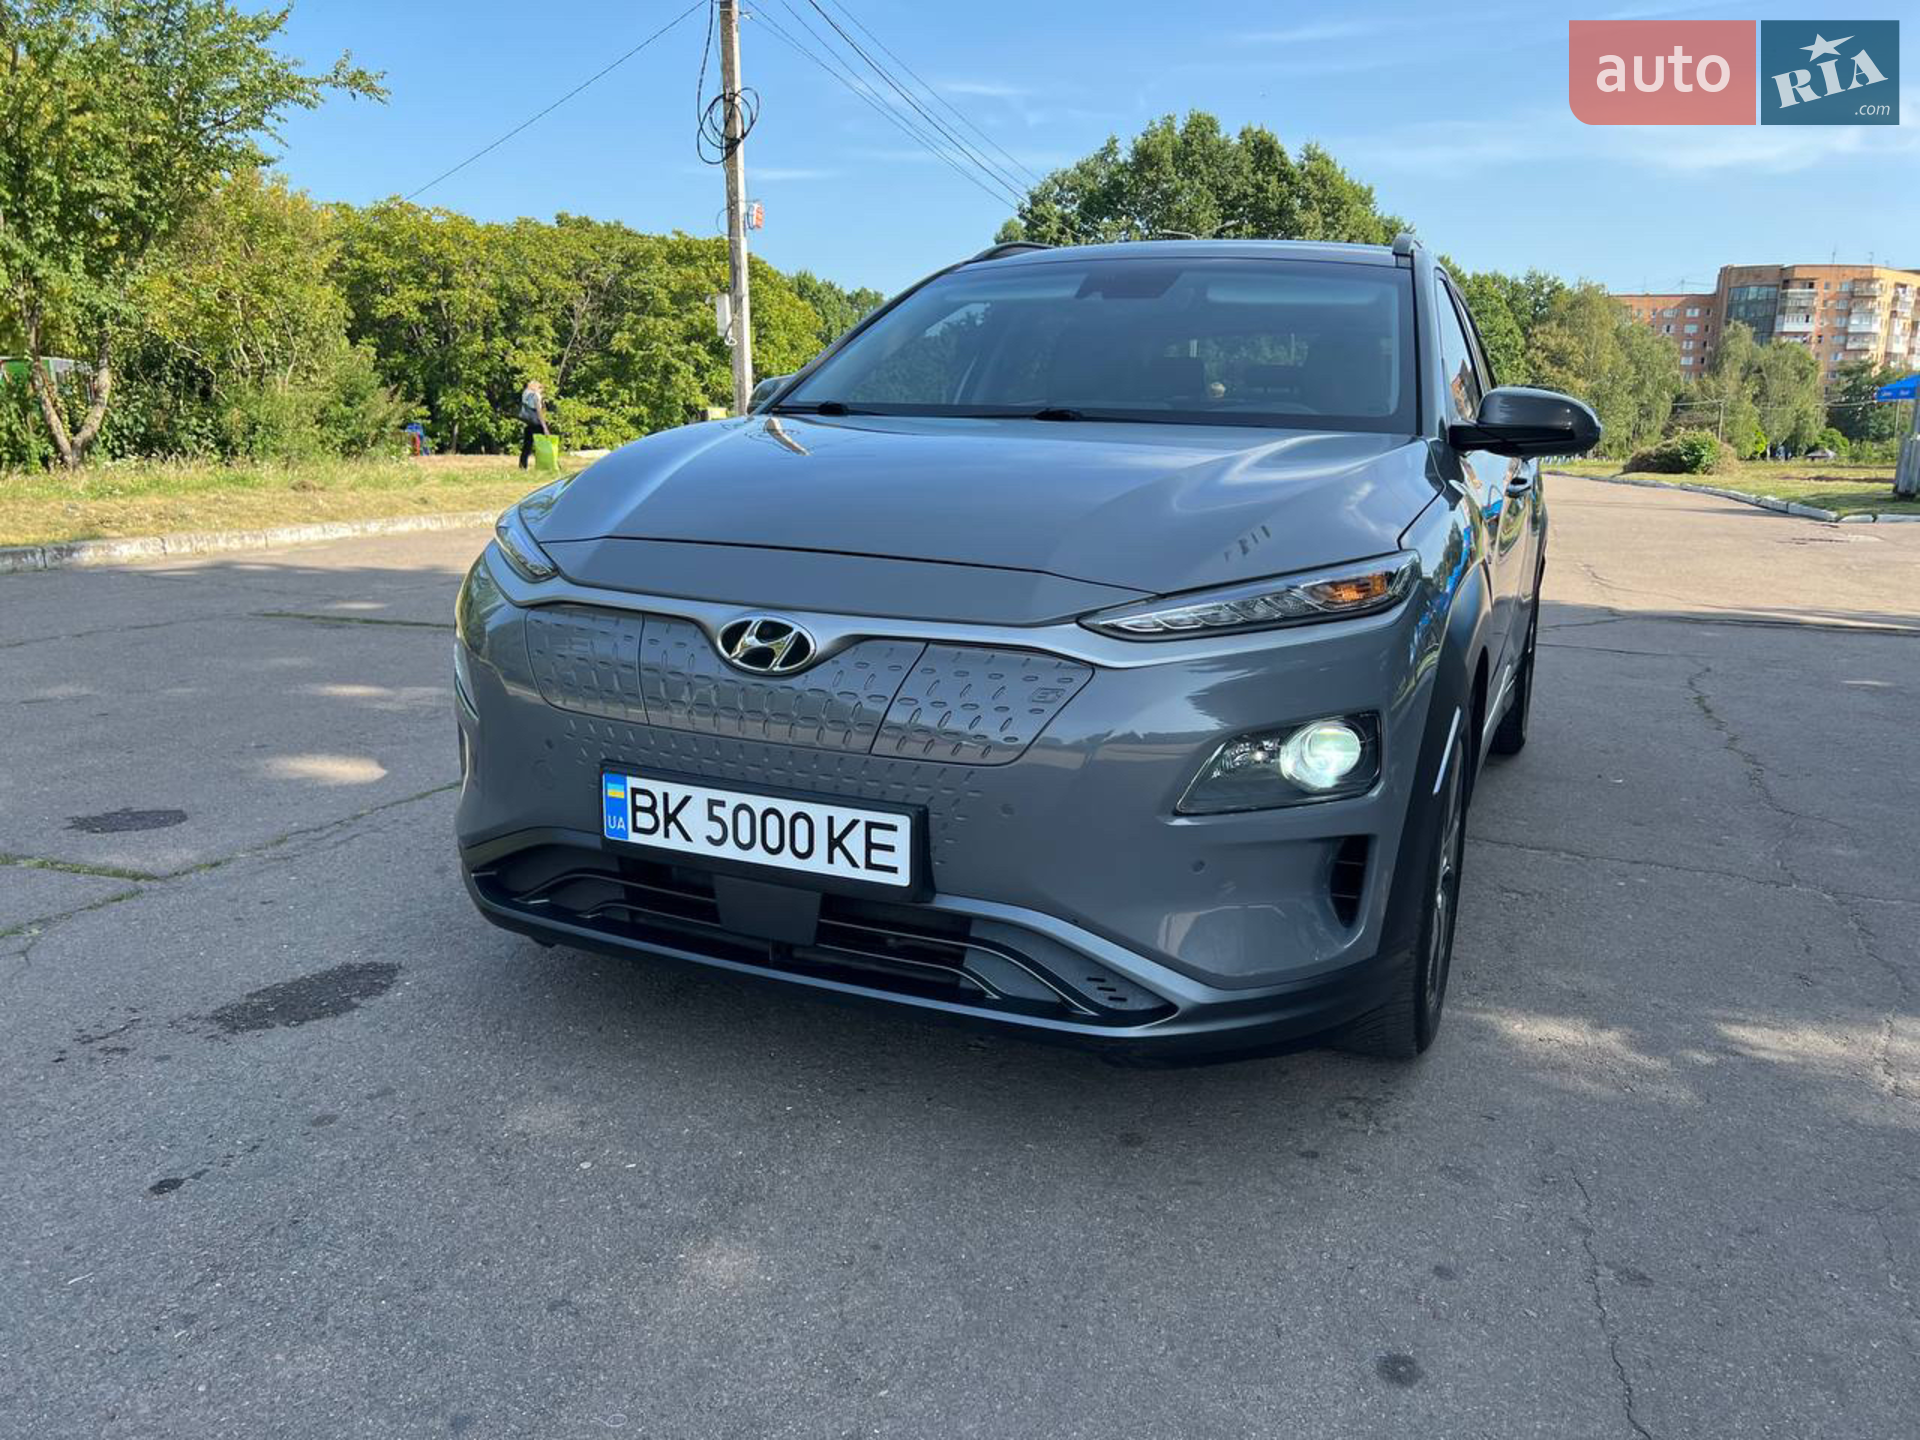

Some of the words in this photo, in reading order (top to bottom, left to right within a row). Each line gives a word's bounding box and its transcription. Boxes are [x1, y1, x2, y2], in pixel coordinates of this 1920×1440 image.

[607, 815, 627, 831] UA
[630, 786, 693, 842] BK
[705, 798, 815, 860] 5000
[827, 815, 899, 874] KE
